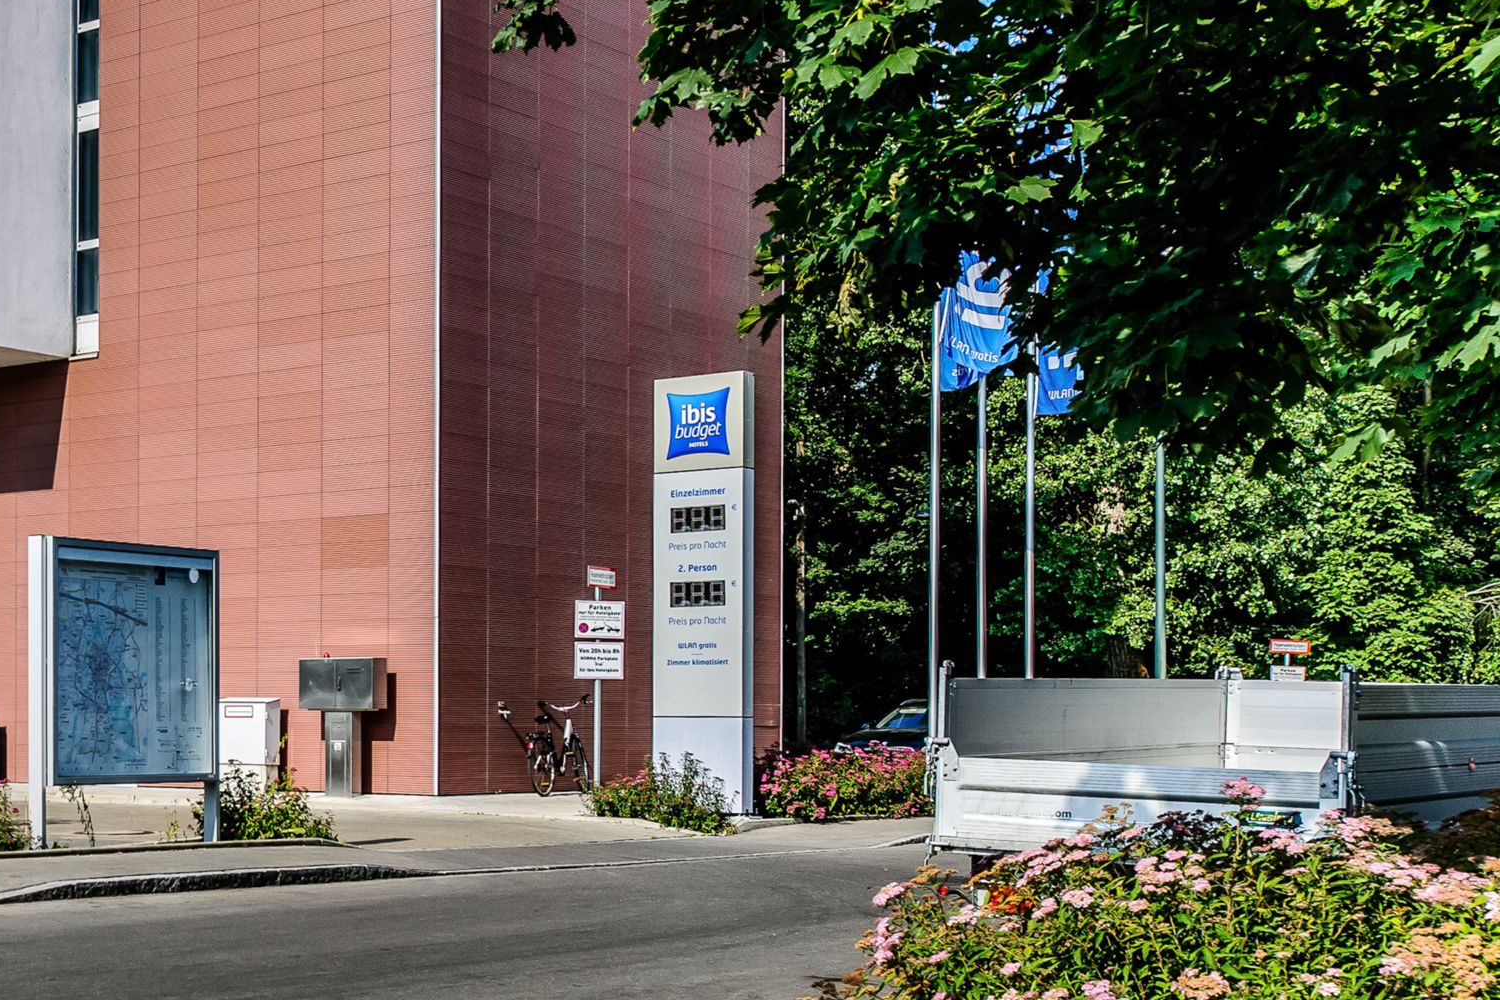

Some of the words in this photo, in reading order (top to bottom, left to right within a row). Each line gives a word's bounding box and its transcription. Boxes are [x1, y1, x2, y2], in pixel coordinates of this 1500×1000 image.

[681, 402, 716, 425] ibis
[674, 421, 722, 440] budget
[670, 488, 726, 499] Einzelzimmer
[668, 542, 688, 551] Preis
[689, 543, 702, 551] pro
[703, 541, 727, 549] Nacht
[678, 564, 686, 573] 2.
[688, 564, 718, 572] Person
[668, 617, 688, 626] Preis
[689, 618, 702, 626] pro
[703, 616, 726, 624] Nacht
[698, 642, 717, 650] gratis
